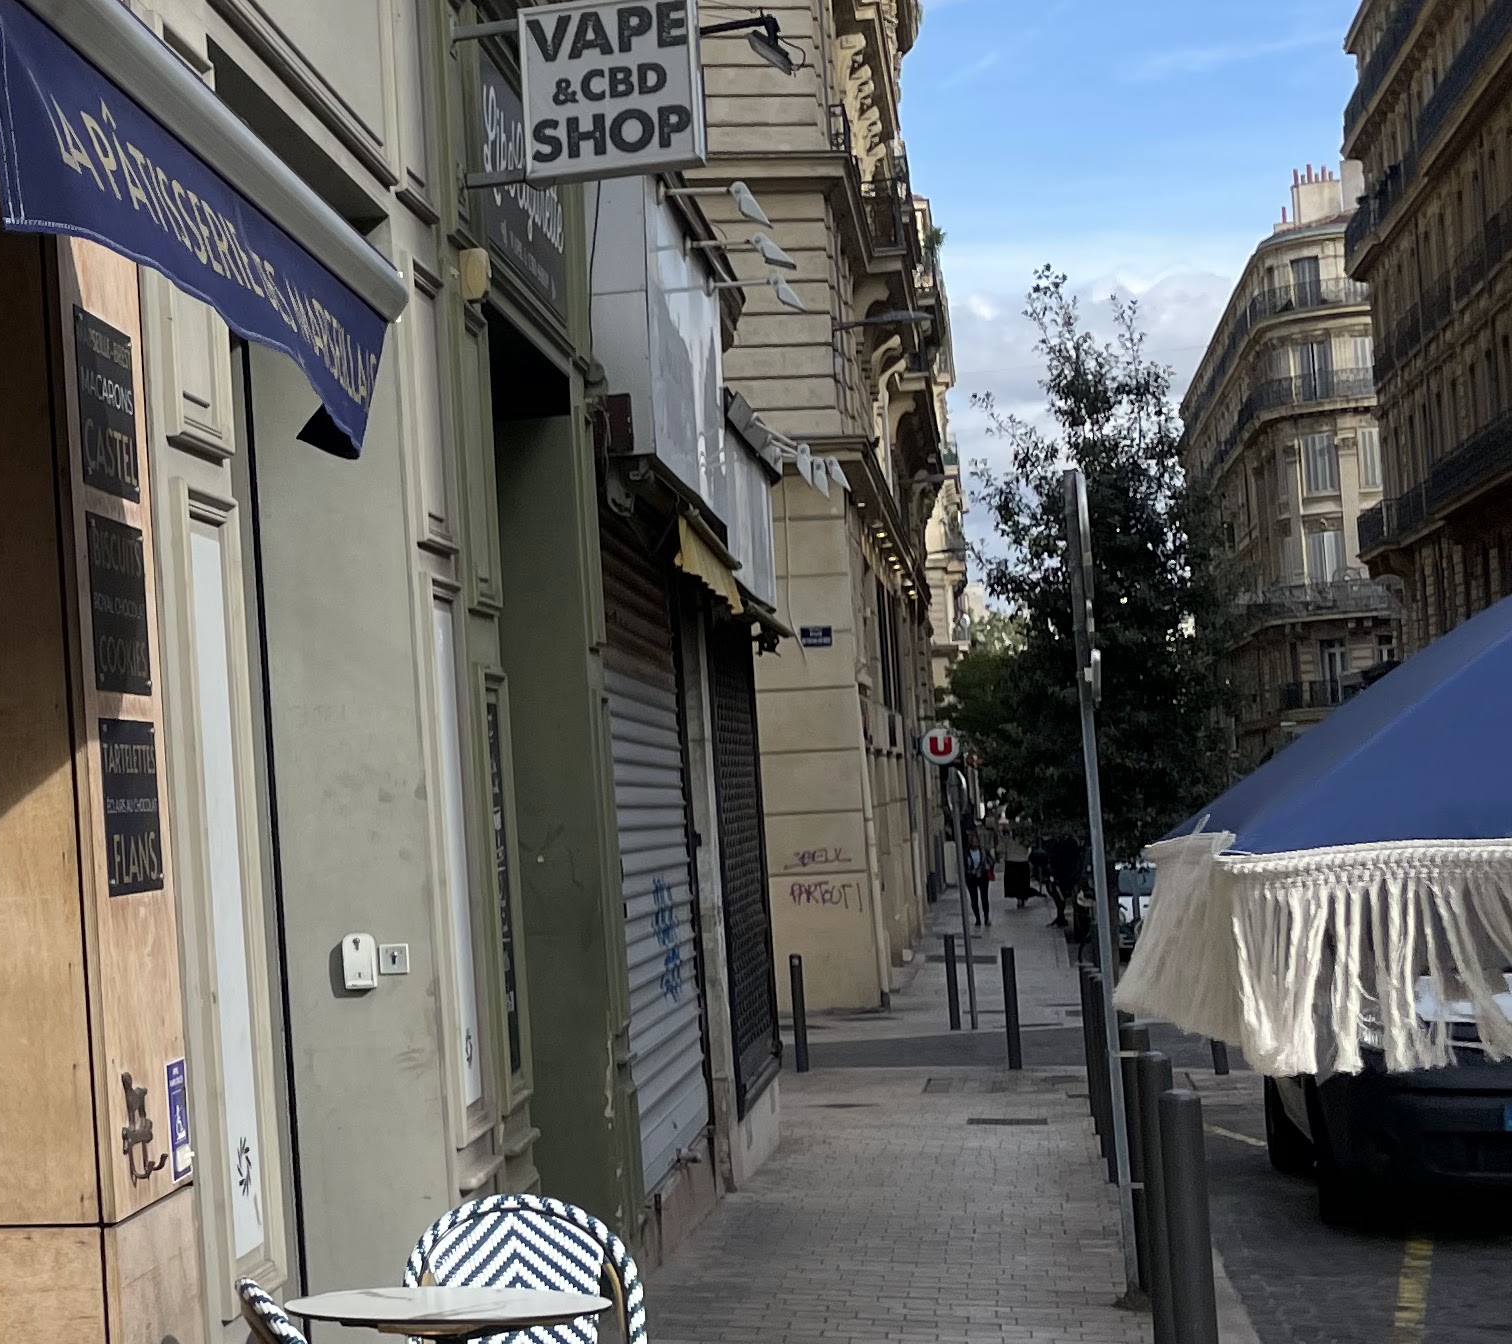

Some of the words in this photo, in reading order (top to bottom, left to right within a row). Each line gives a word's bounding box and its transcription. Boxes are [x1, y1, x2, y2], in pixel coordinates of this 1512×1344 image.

[526, 0, 687, 63] VAPE
[532, 104, 692, 164] SHOP
[43, 91, 105, 193] LA
[79, 96, 266, 299] PÂTISSERIE
[81, 365, 134, 416] MACARONS
[84, 417, 139, 487] CASTEL
[91, 526, 143, 578] BISCUITS
[98, 634, 149, 678] COOKIES
[102, 742, 157, 775] TARTELETTES
[929, 736, 952, 757] U
[113, 830, 159, 886] FLANS
